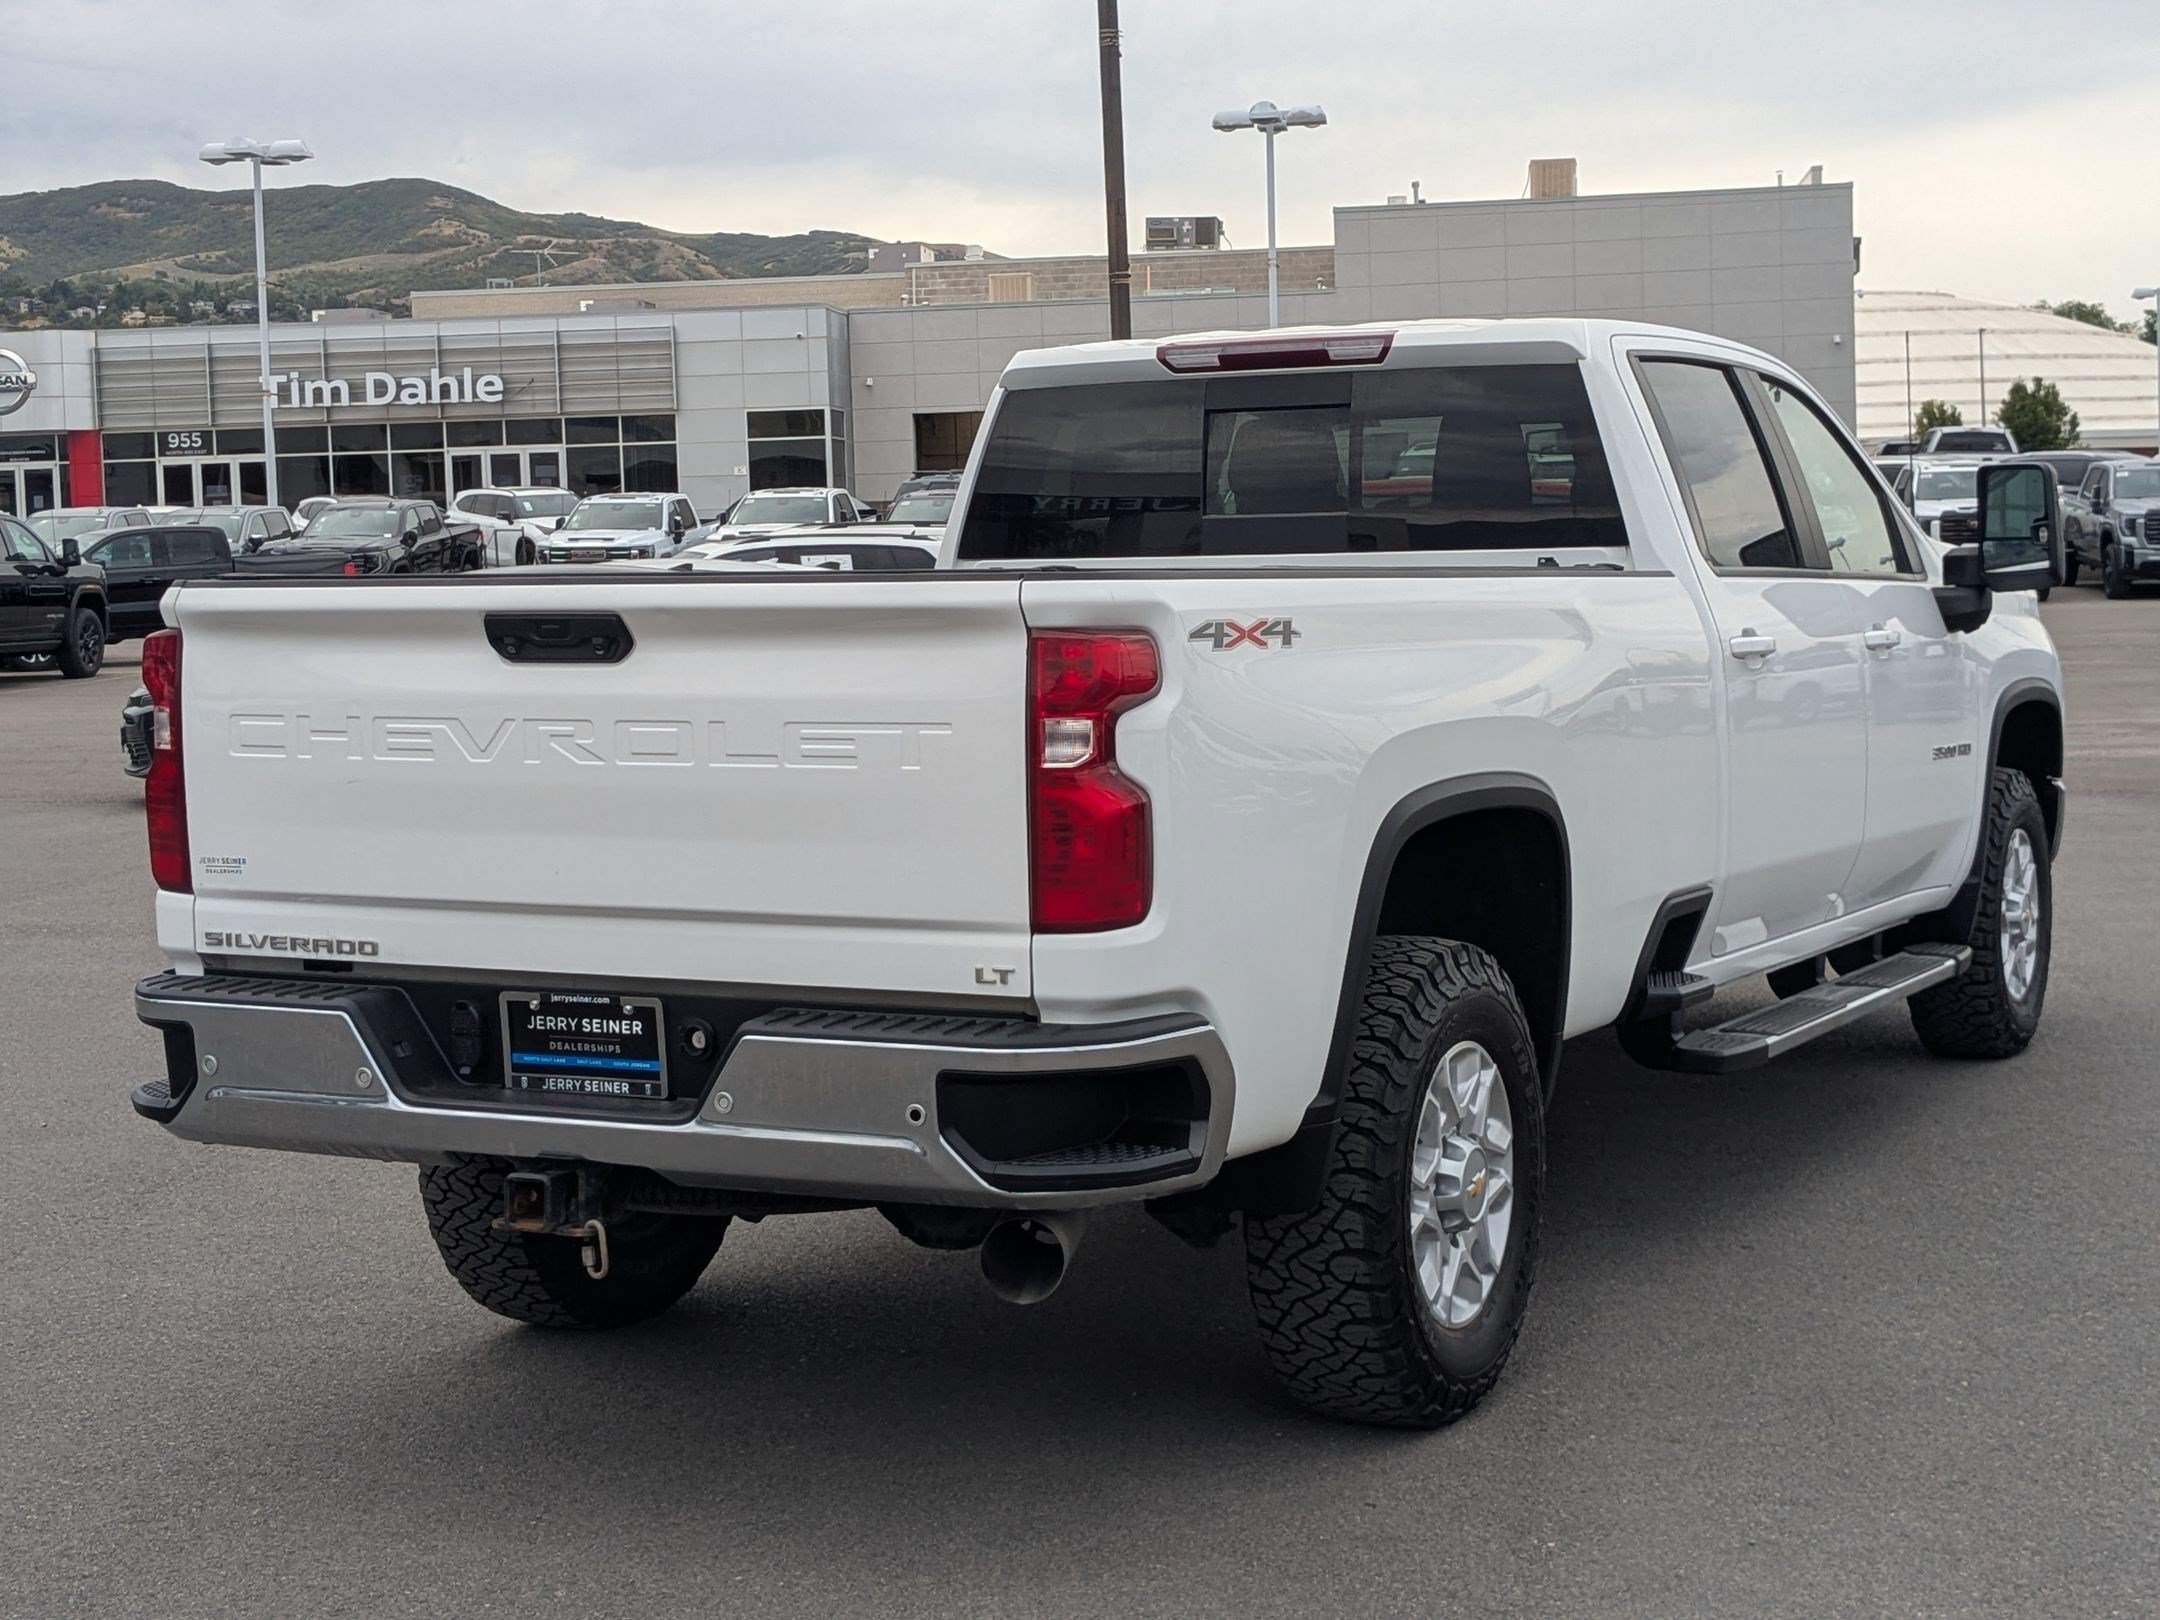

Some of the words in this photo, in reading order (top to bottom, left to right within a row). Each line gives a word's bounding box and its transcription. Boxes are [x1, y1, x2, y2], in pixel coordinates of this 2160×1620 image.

[259, 371, 350, 408] Tim
[365, 366, 504, 406] Dahle
[168, 432, 202, 448] 955
[229, 714, 953, 770] CHEVROLET
[221, 857, 247, 865] SEINER
[205, 932, 379, 956] SILVERADO
[975, 967, 1016, 985] LT
[551, 994, 610, 1004] jerryseiner.com
[527, 1016, 578, 1031] JERRY
[582, 1018, 643, 1035] SEINER
[549, 1041, 621, 1053] DEALERSHIPS
[542, 1078, 581, 1092] JERRY
[584, 1080, 630, 1094] SEINER
